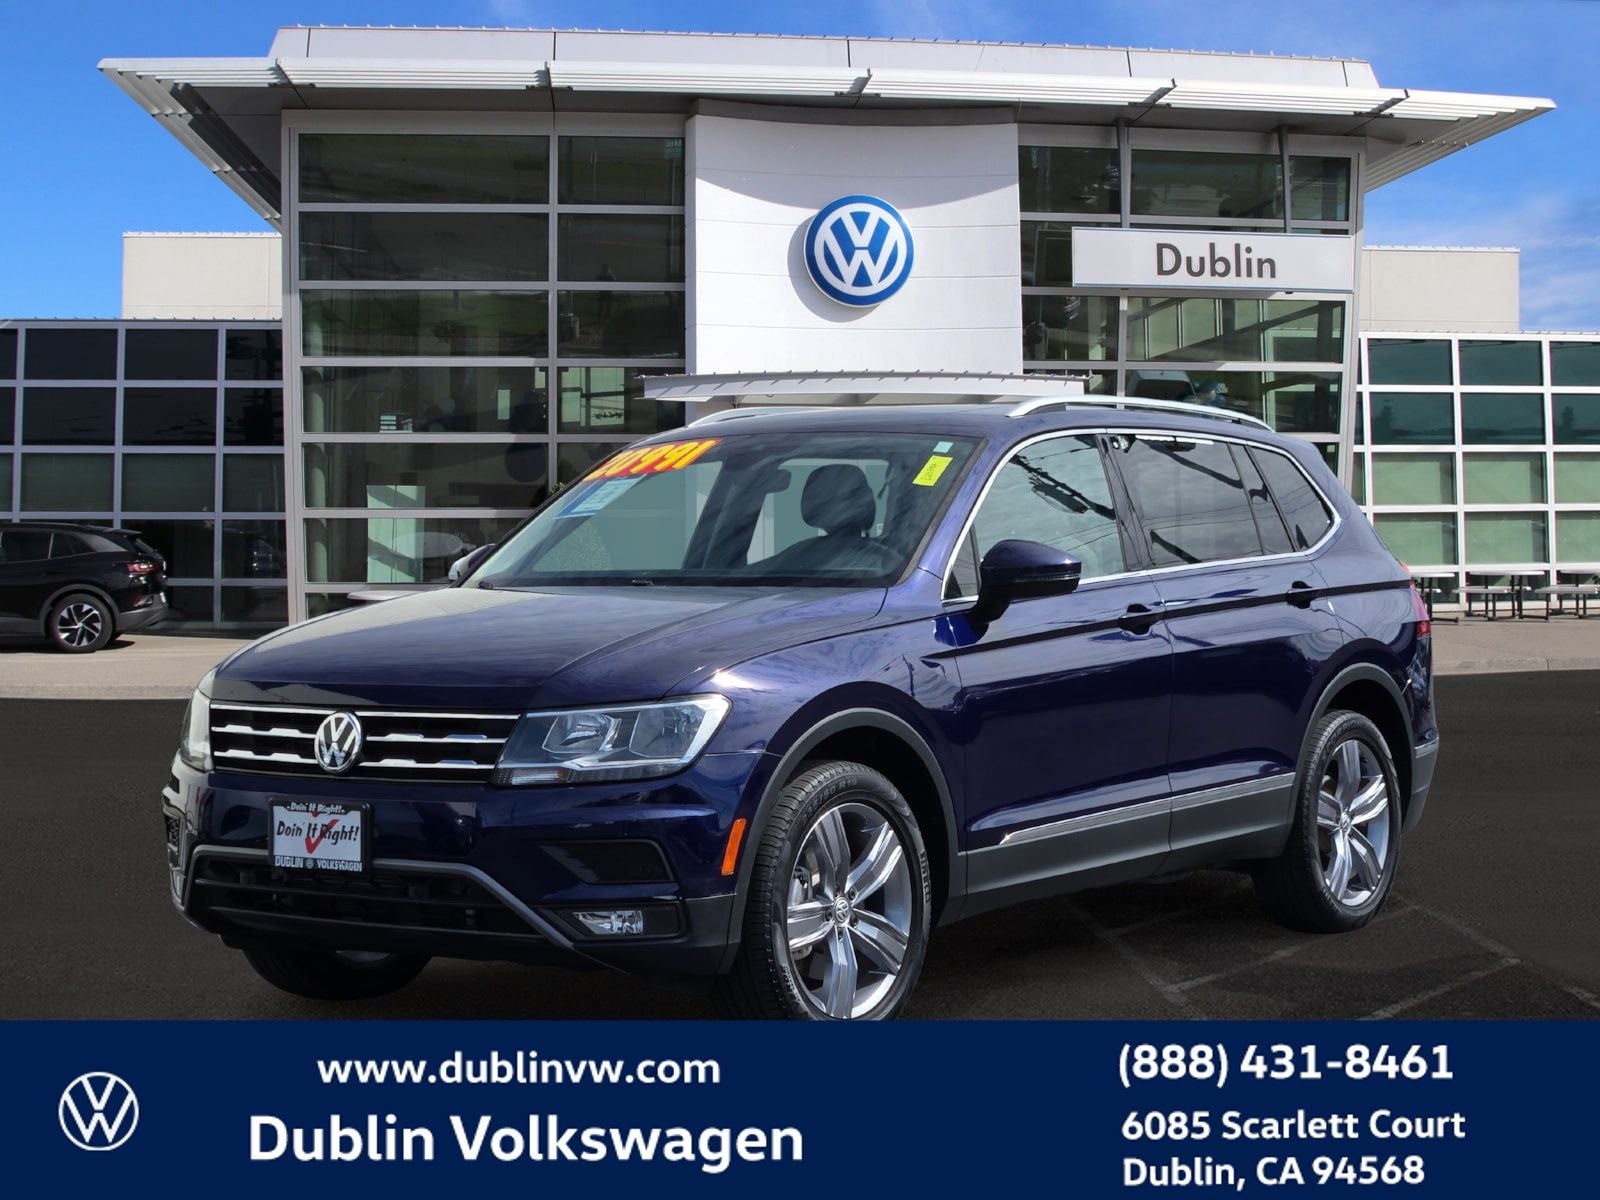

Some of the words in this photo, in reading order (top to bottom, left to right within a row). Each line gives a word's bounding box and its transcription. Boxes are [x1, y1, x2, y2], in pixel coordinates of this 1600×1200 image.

[1156, 242, 1276, 279] Dublin
[276, 820, 305, 837] Doin'
[306, 822, 318, 839] It
[320, 823, 359, 846] Right!
[274, 855, 304, 868] DUBLIN
[316, 859, 363, 872] VOLKSWAGEN
